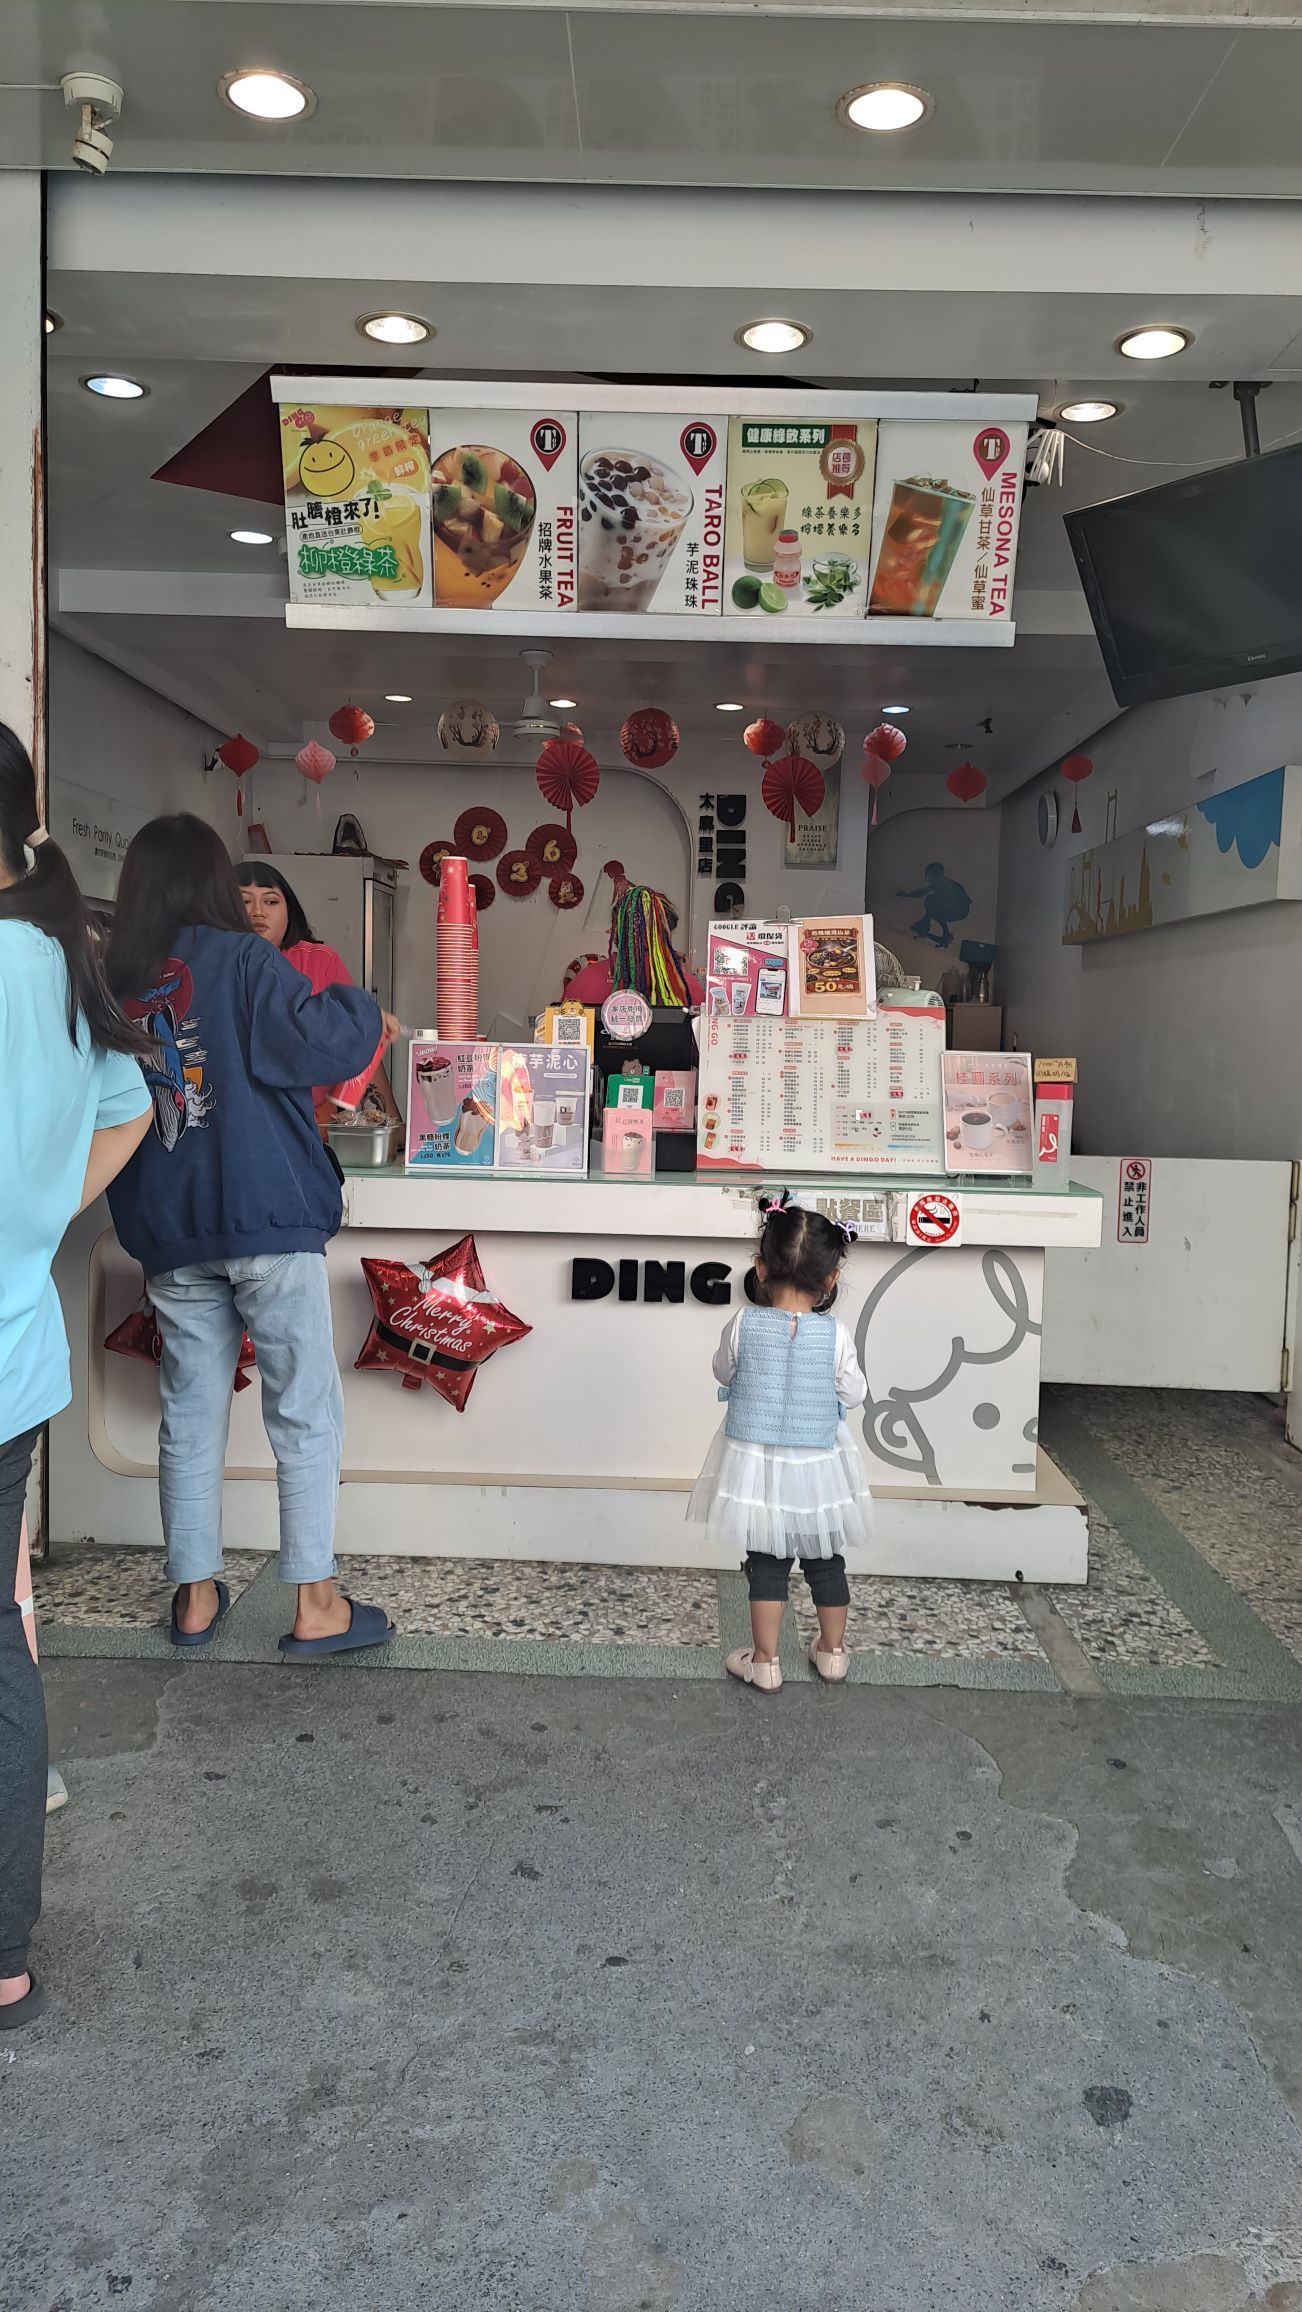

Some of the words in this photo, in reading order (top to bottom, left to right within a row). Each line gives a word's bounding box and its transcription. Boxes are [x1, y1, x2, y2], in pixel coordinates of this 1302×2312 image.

[746, 427, 825, 444] 健康綠飲系列
[291, 497, 380, 530] 肚臍橙來了!
[703, 484, 722, 546] TARO
[801, 506, 862, 521] 綠茶養樂多
[801, 523, 860, 536] 檸檬養樂多
[993, 472, 1017, 568] MESONA
[556, 506, 574, 563] FRUIT
[971, 487, 995, 611] 仙草甘茶/仙草蜜
[300, 545, 398, 577] 柳橙綠茶
[538, 522, 553, 600] 招牌水果茶
[684, 542, 700, 609] 芋泥珠珠
[557, 569, 574, 608] TEA
[701, 554, 720, 609] BALL
[989, 574, 1008, 616] TEA
[72, 817, 90, 838] Fresh
[798, 824, 827, 832] PRAISE
[711, 1032, 718, 1046] GO
[513, 1053, 578, 1070] 芋泥心
[955, 1071, 1017, 1086] 桂圓系列
[434, 1143, 450, 1151] 奶茶
[1122, 1181, 1136, 1238] 禁止進入
[1134, 1182, 1148, 1238] 非工作人員
[389, 1306, 473, 1353] Christmas
[414, 1295, 473, 1335] Merry
